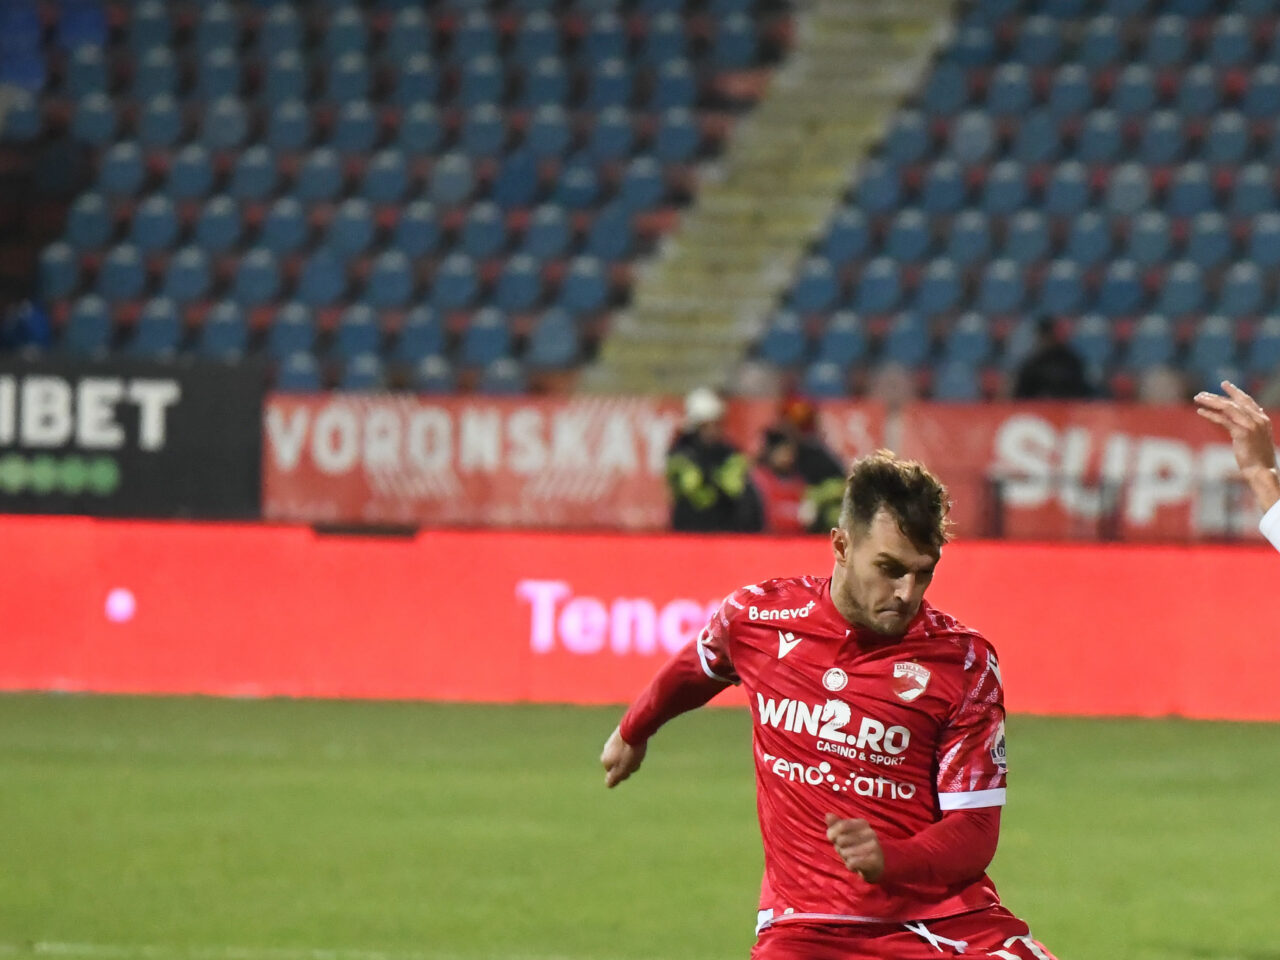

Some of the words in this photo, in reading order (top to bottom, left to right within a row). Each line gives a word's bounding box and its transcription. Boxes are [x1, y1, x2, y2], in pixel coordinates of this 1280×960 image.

[757, 692, 911, 755] WIN2.RO
[816, 740, 857, 759] CASINO
[859, 751, 866, 761] &
[869, 753, 906, 766] SPORT
